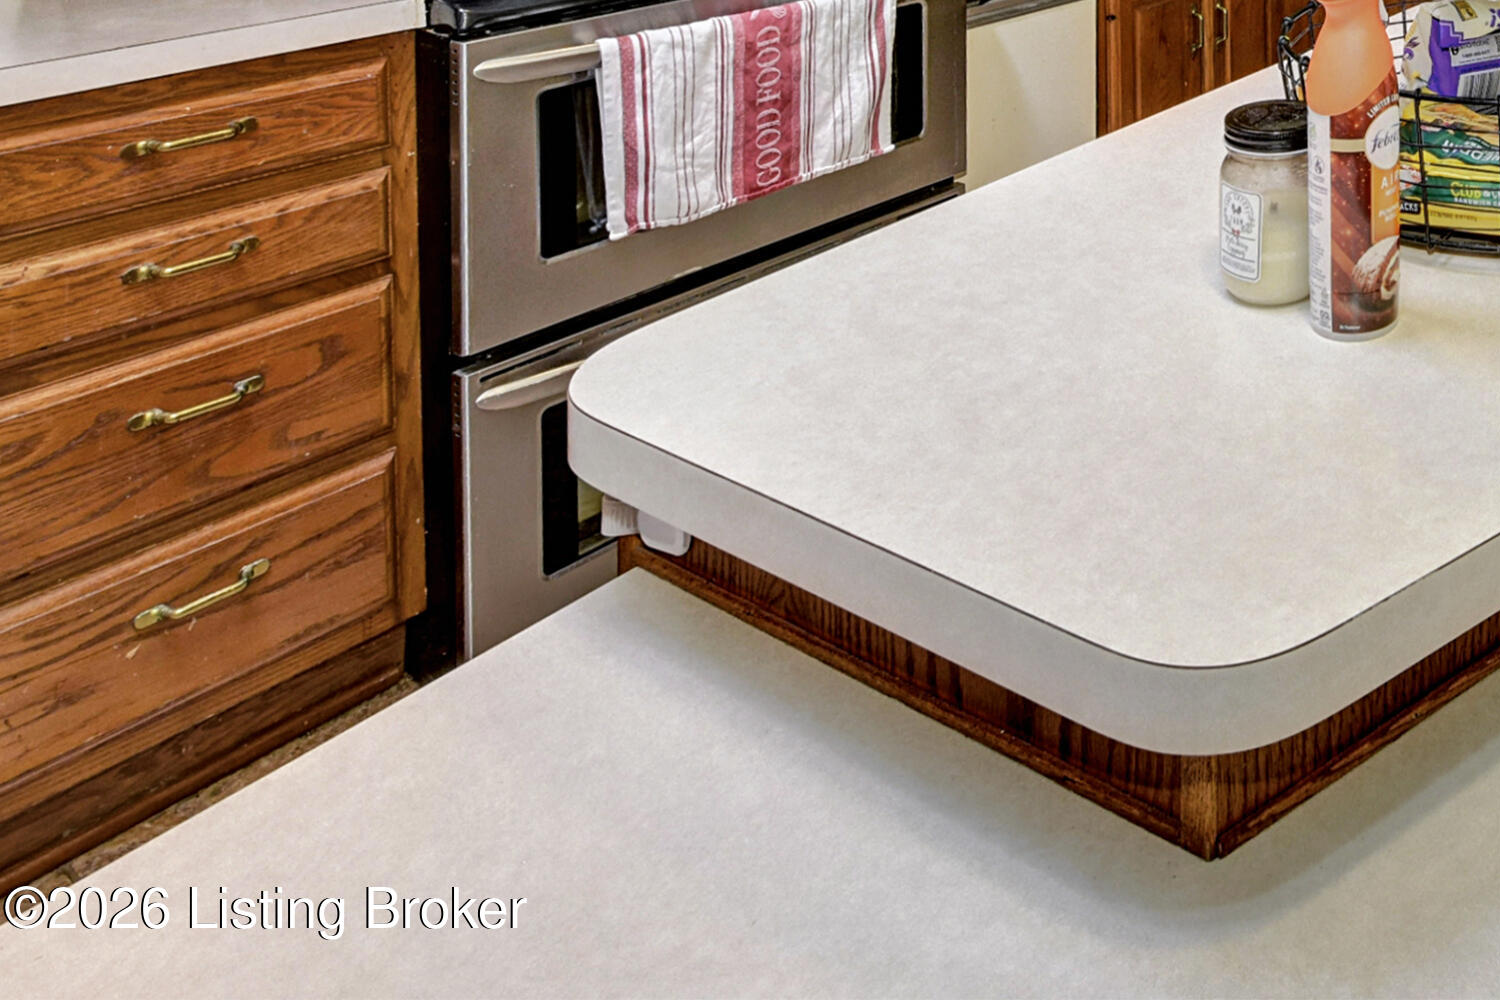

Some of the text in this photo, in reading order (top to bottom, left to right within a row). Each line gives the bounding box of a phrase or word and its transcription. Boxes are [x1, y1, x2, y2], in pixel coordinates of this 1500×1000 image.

[756, 25, 782, 187] GOOD FOOD
[1450, 181, 1482, 198] CLUB
